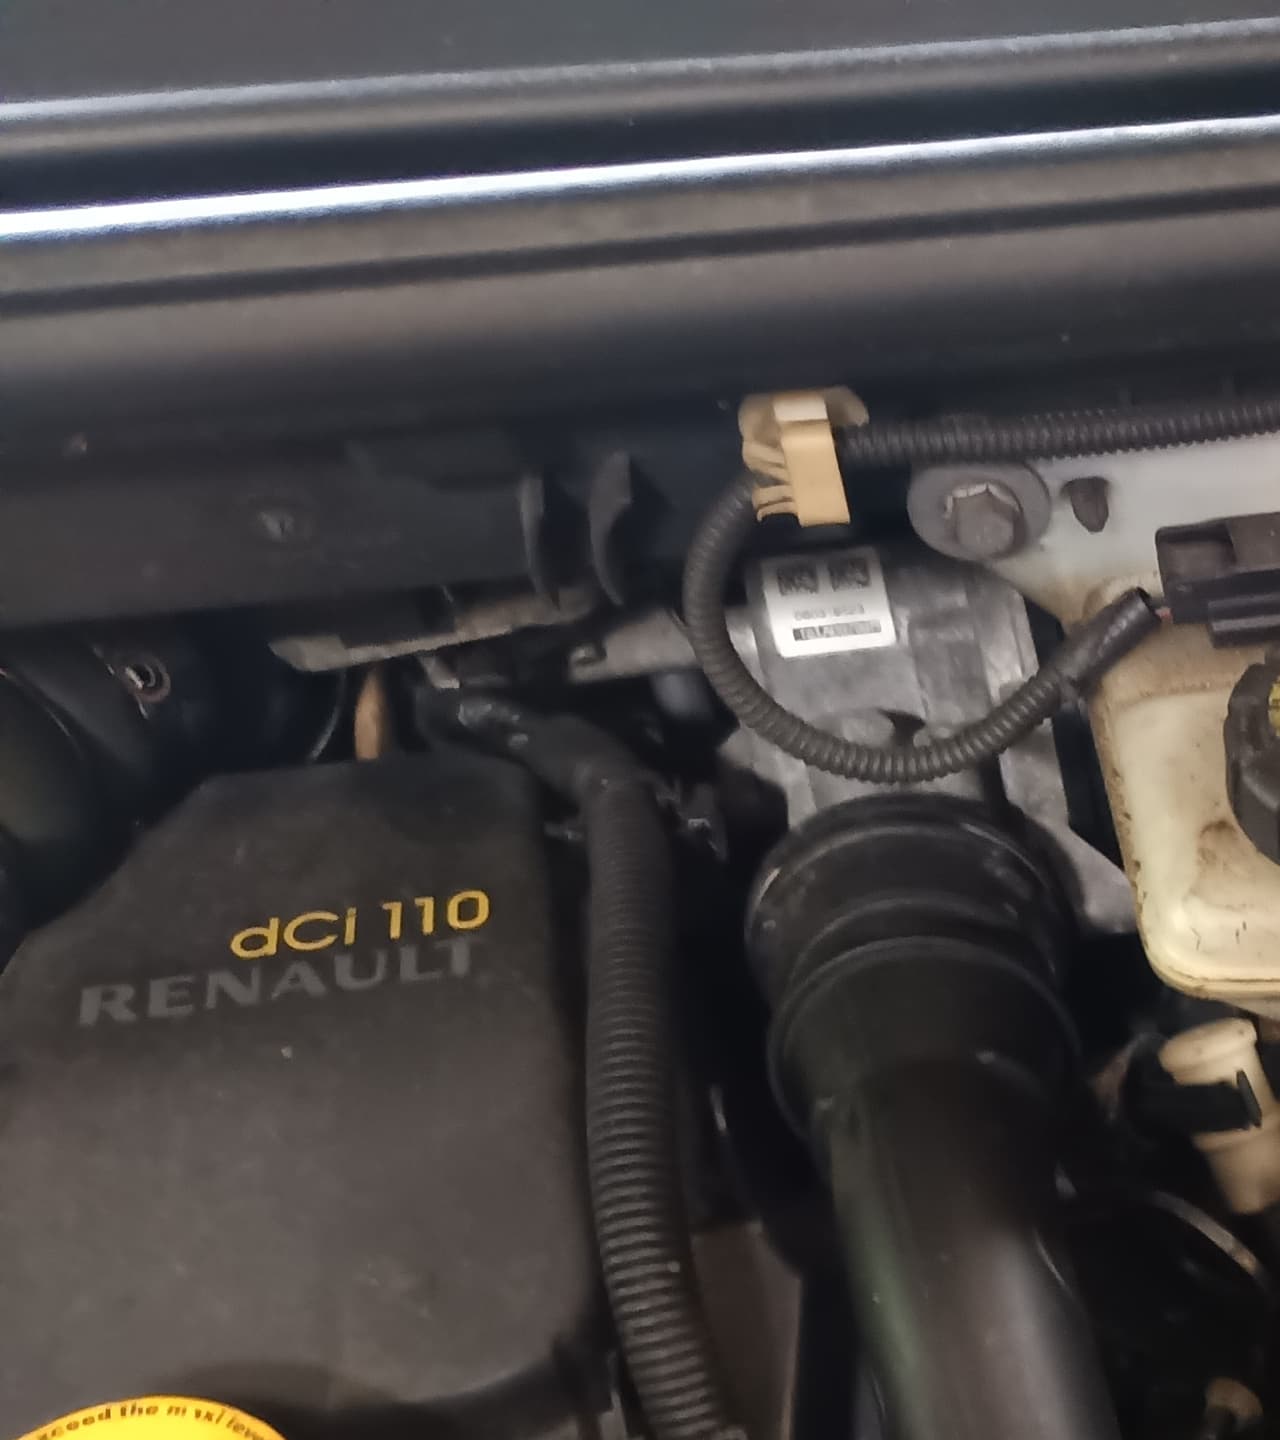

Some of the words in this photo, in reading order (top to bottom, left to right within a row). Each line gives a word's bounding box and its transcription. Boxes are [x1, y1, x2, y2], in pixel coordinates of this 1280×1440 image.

[229, 906, 357, 960] dCi
[381, 889, 491, 940] 110
[76, 936, 485, 1028] RENAULT
[119, 1402, 158, 1417] the
